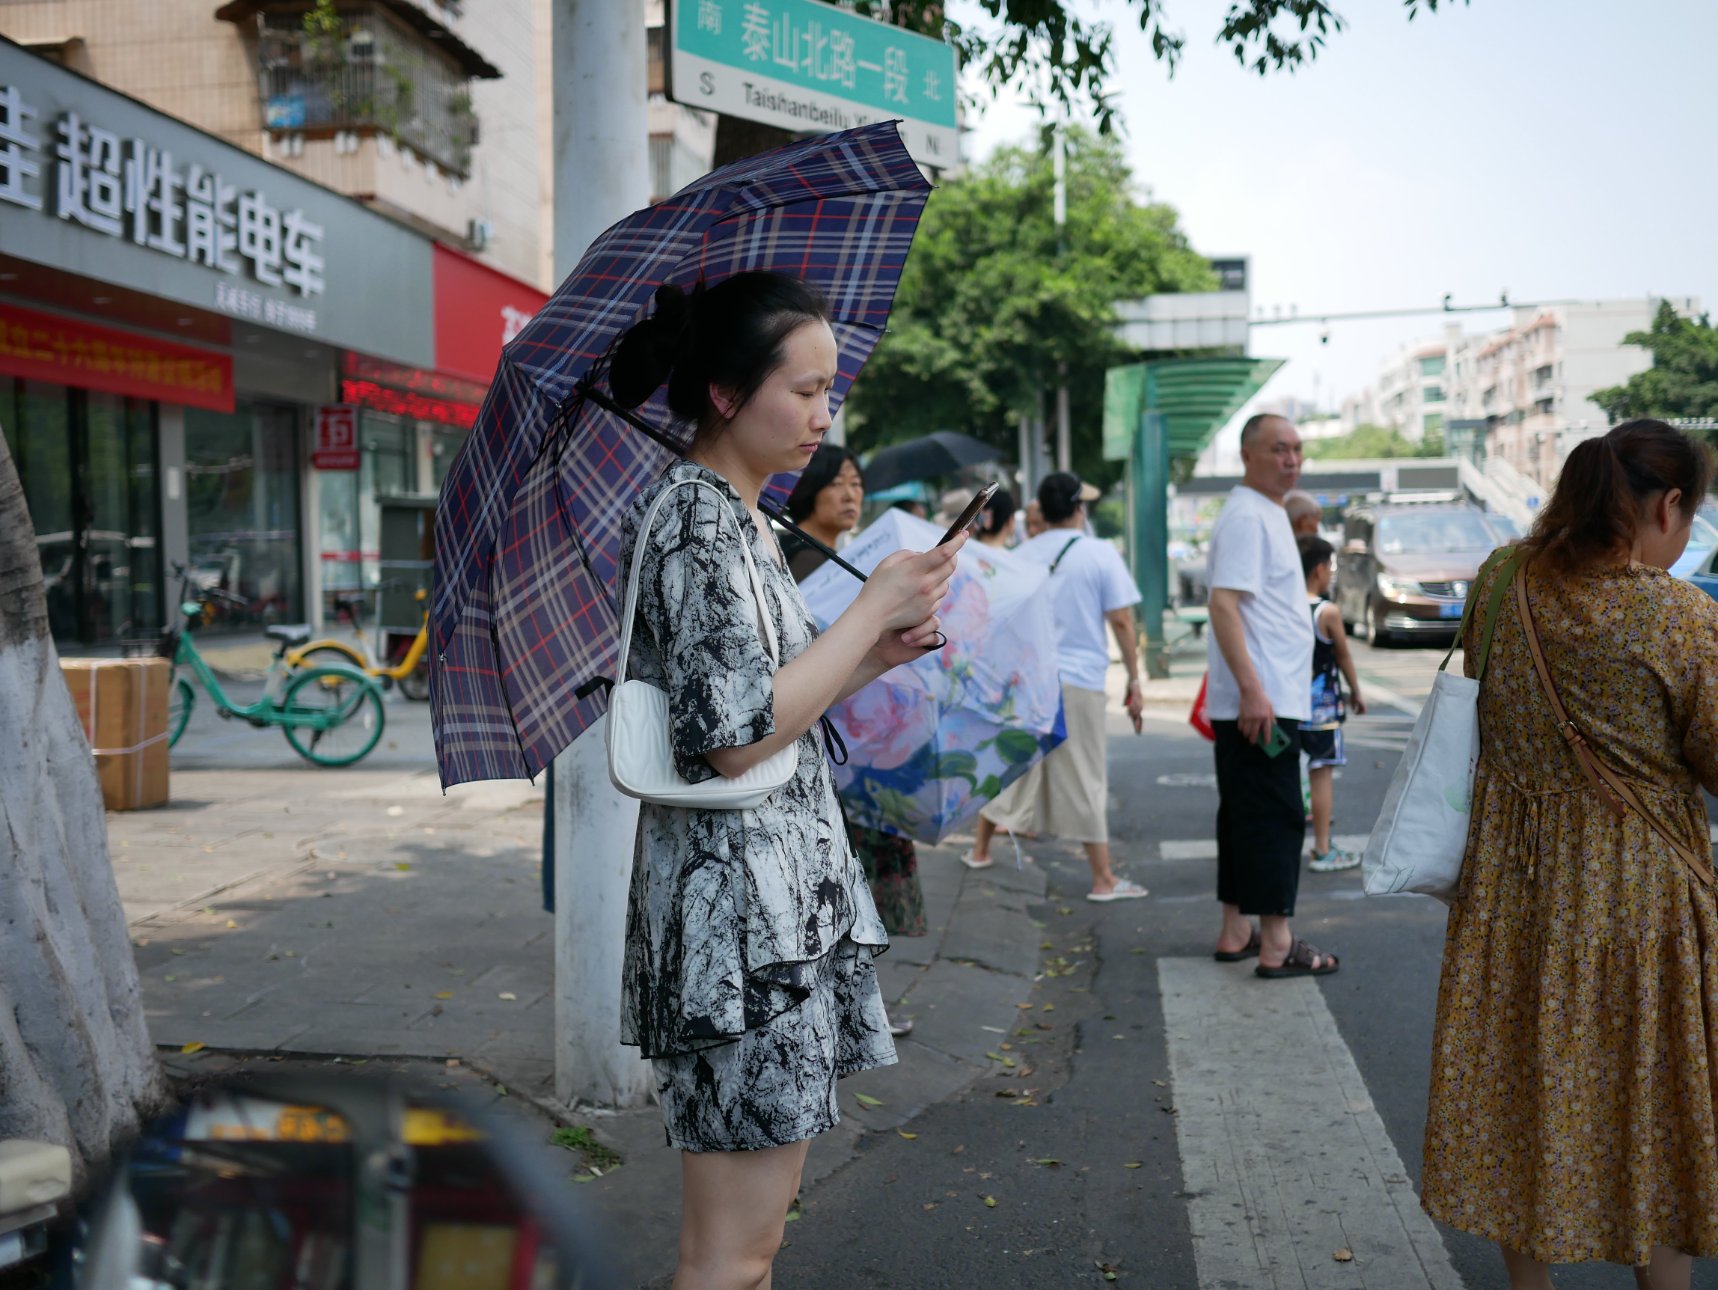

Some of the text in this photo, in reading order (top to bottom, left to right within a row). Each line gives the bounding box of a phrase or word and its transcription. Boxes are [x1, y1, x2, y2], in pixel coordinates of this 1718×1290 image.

[698, 0, 941, 103] 南 泰山北路一段 北
[699, 71, 715, 96] S
[742, 82, 849, 129] Taishanbeilu
[927, 134, 942, 155] N
[58, 112, 325, 297] 超性能电车
